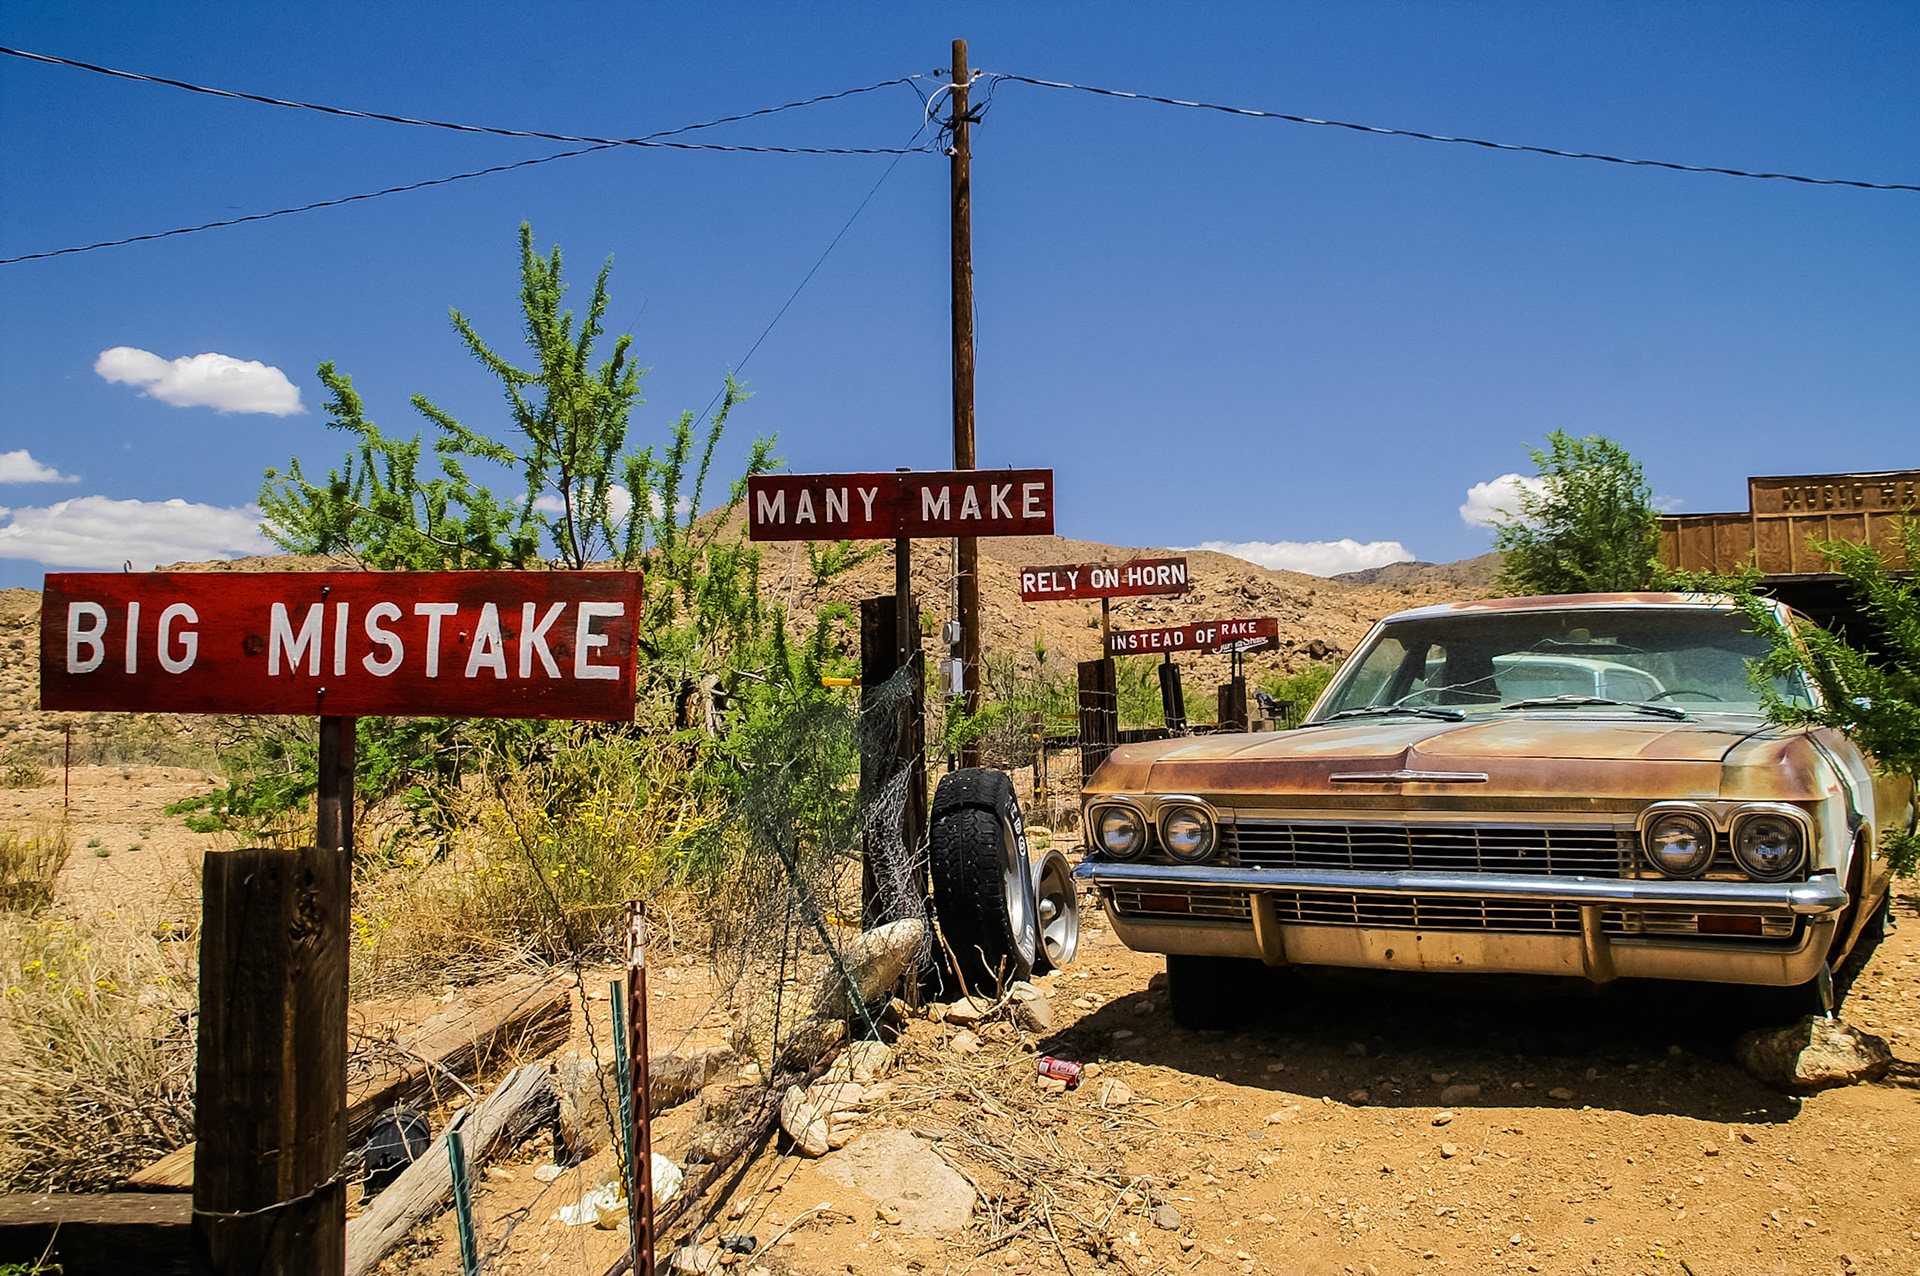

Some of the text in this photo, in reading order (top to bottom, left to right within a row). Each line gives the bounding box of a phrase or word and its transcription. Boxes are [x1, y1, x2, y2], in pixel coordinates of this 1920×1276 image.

[757, 482, 1047, 525] MANY MAKE
[1022, 564, 1186, 593] RELY ON HORN
[66, 601, 625, 681] BIG MISTAKE
[1110, 621, 1257, 651] INSTEAD OF RAKE
